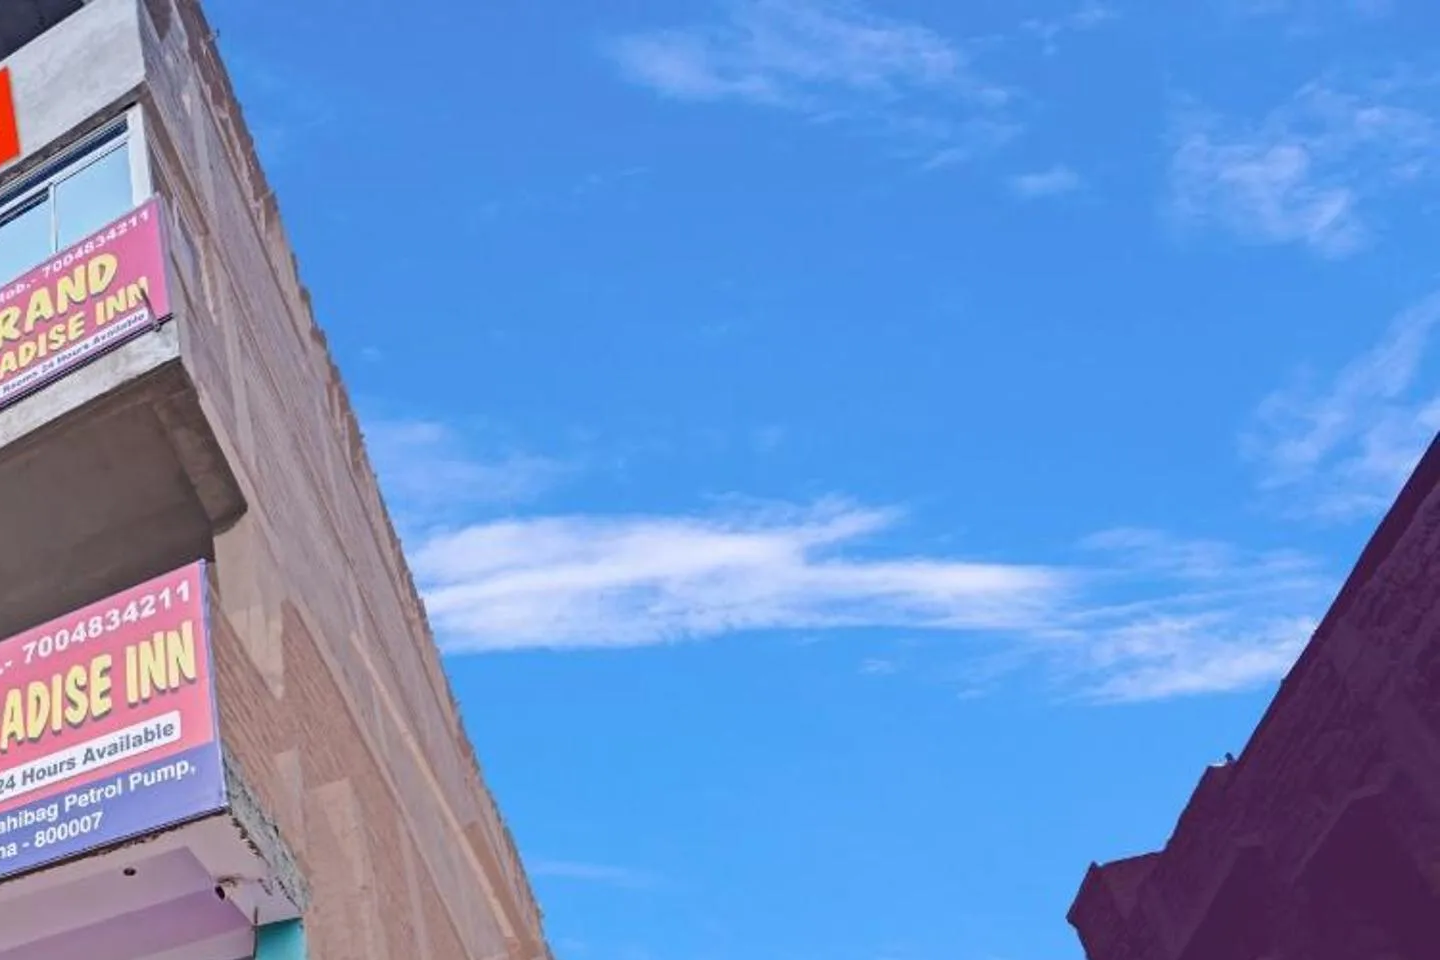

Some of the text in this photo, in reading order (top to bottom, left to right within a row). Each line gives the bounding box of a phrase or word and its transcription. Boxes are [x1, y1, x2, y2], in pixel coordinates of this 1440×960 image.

[42, 211, 150, 278] 7004834211
[95, 276, 149, 326] INN
[21, 579, 191, 665] 7004834211
[125, 620, 197, 704] INN
[21, 757, 76, 786] Hours
[82, 722, 175, 765] Available
[64, 778, 123, 812] Petrol
[129, 758, 197, 792] Pump,
[34, 812, 104, 849] 800007
